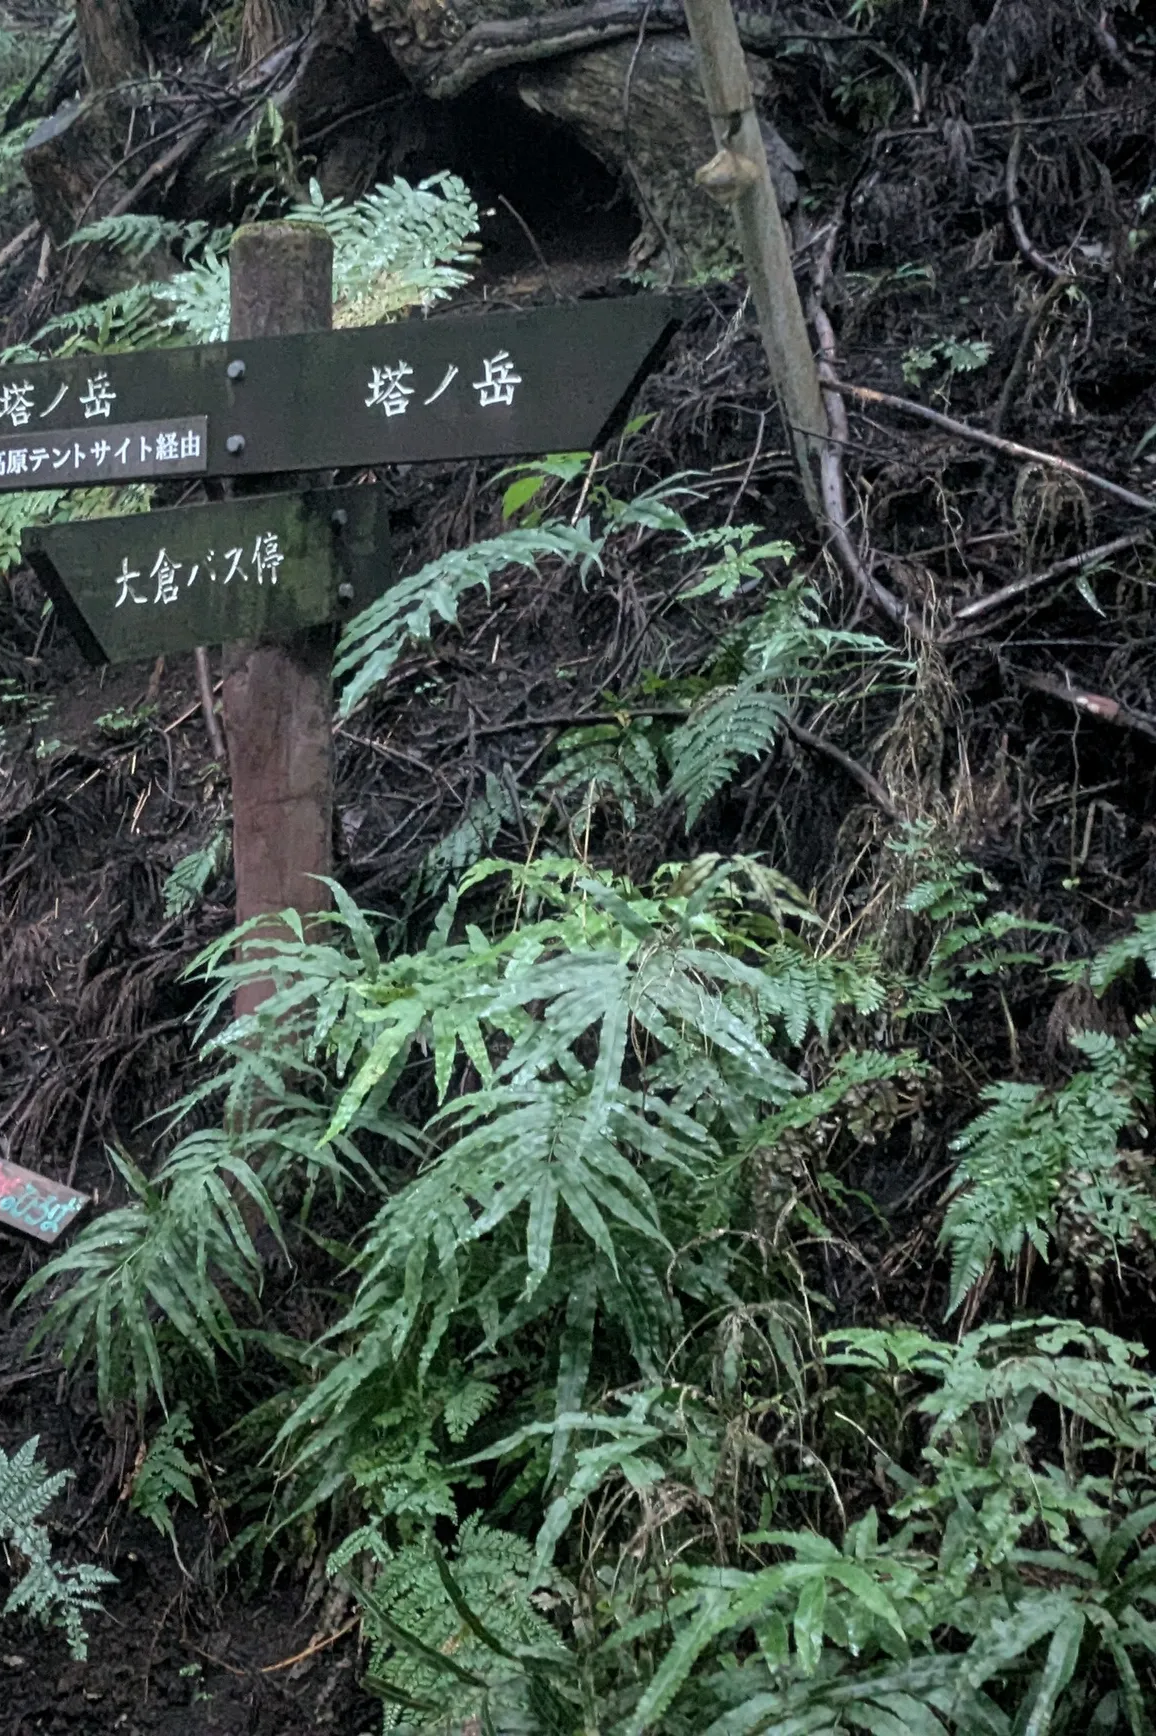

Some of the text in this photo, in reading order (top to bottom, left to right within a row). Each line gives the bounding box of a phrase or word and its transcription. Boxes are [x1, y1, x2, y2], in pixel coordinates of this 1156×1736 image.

[365, 350, 522, 417] 塔ノ岳
[115, 532, 284, 608] 大倉バス停
